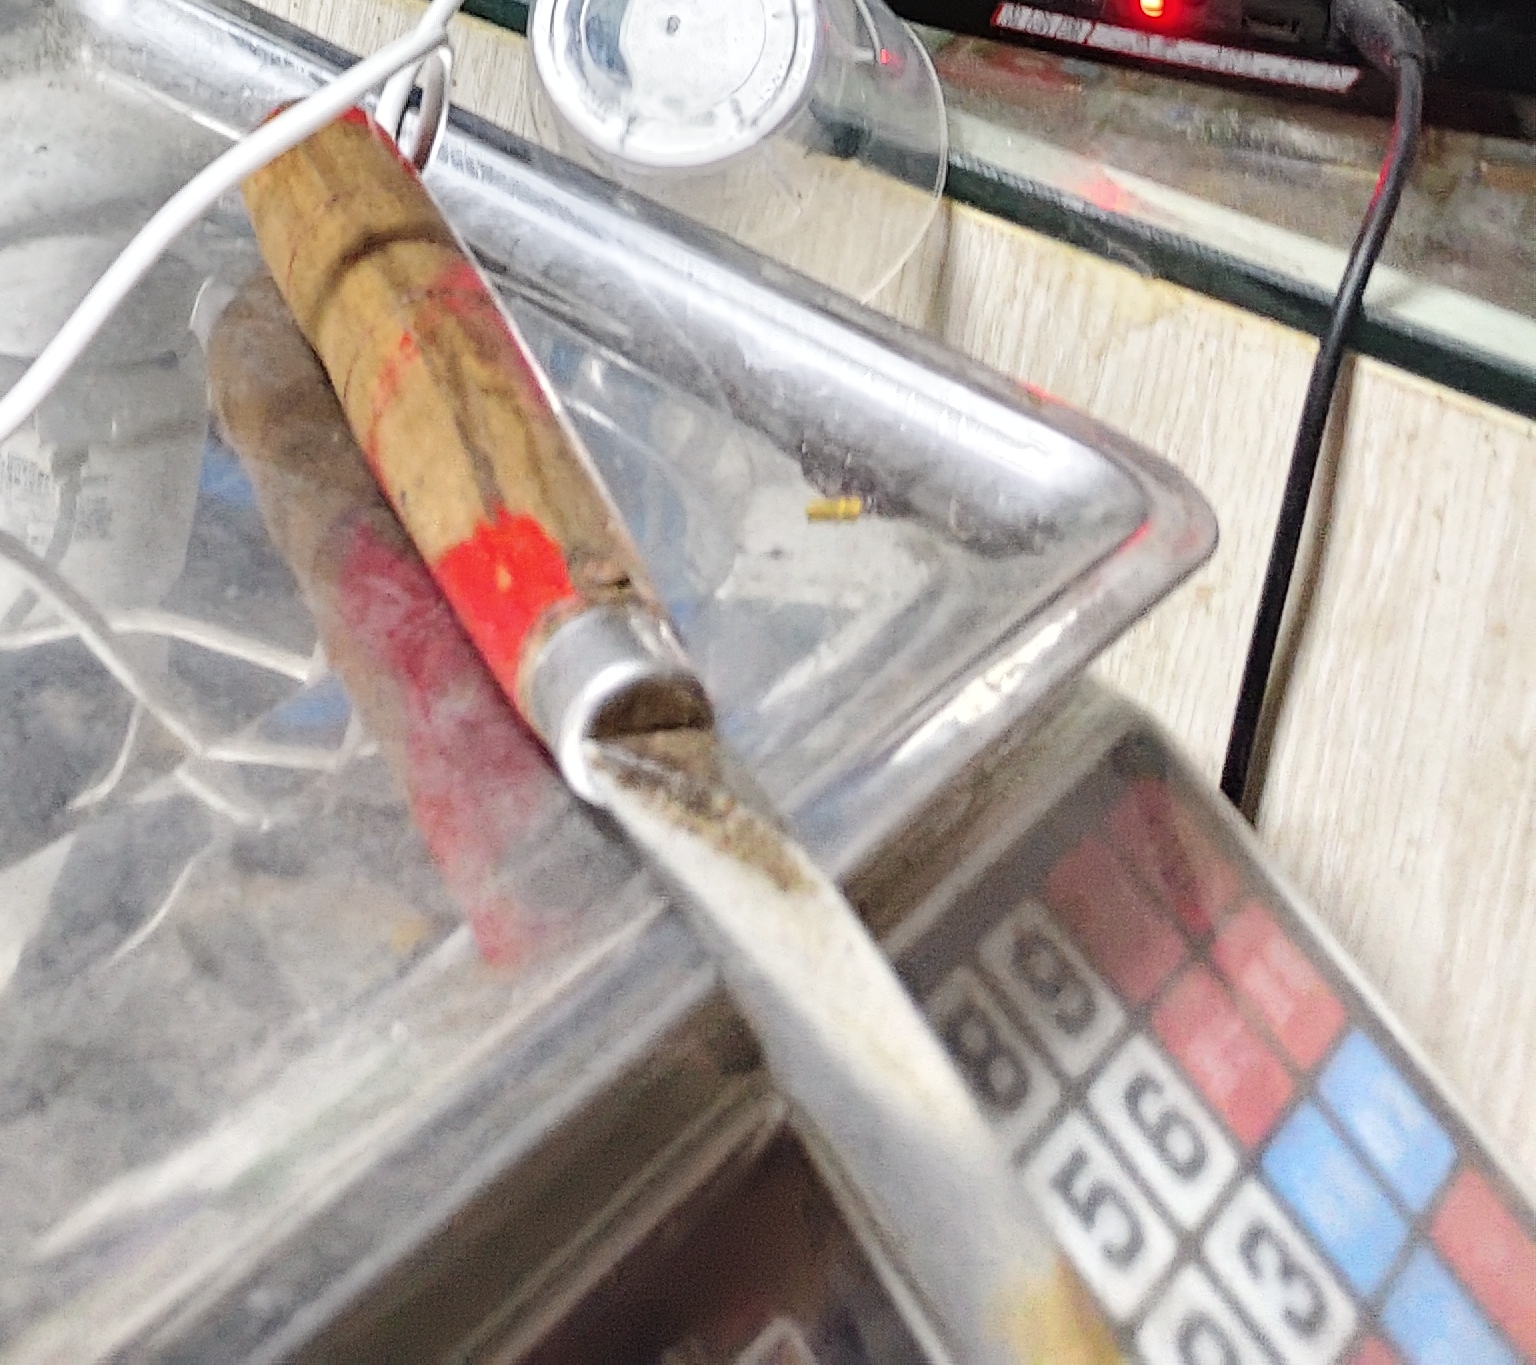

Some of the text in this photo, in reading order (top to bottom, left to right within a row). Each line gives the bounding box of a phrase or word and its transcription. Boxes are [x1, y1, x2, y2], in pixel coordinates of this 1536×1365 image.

[1013, 927, 1100, 1033] 9
[1124, 1073, 1209, 1184] 6
[1054, 1153, 1145, 1267] 5
[1240, 1226, 1328, 1335] 3
